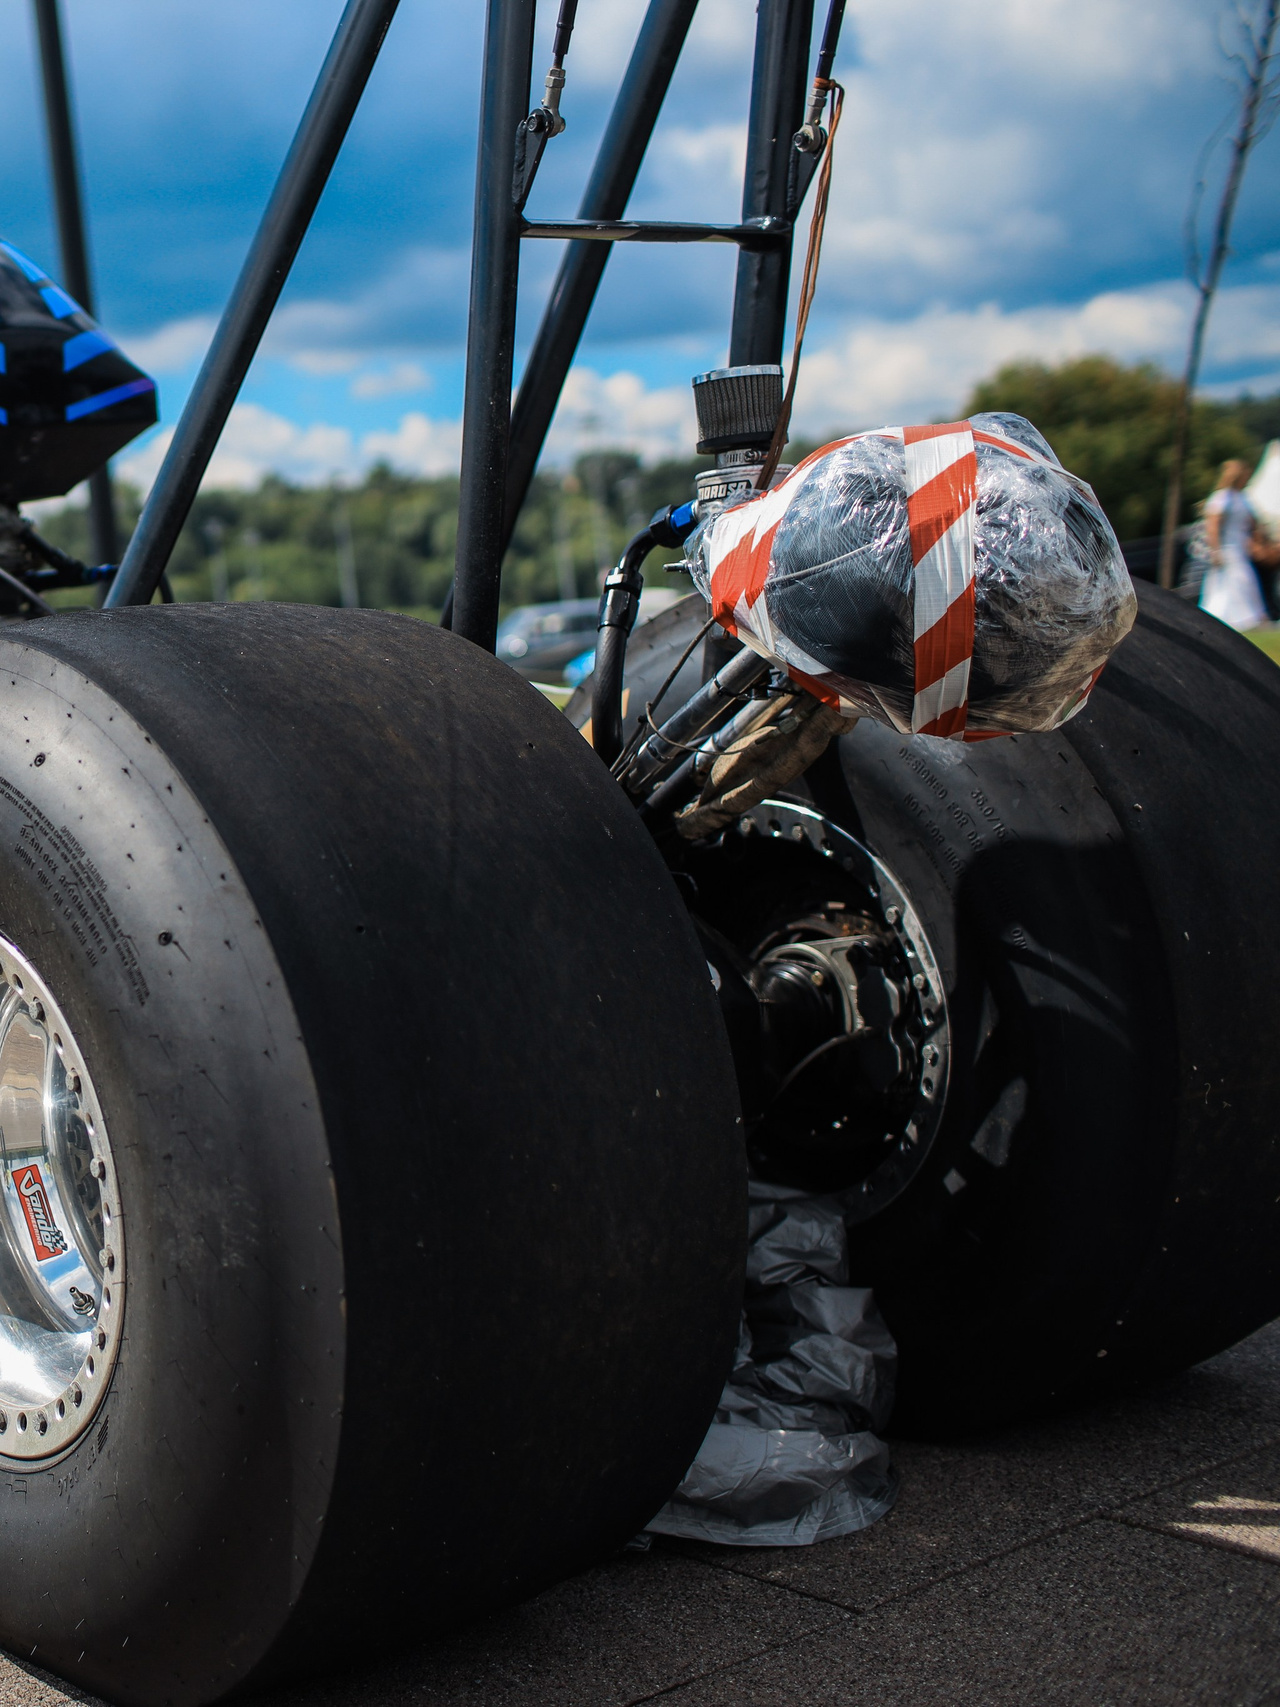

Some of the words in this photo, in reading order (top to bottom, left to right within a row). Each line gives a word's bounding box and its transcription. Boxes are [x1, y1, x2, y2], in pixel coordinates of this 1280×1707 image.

[898, 747, 948, 800] DESIGNED
[947, 802, 969, 828] FOR
[904, 793, 925, 818] NOT
[925, 820, 946, 844] FOR
[18, 827, 59, 875] BEADLOCK
[57, 875, 108, 954] RECOMMENDED
[19, 1170, 54, 1251] Sander
[24, 1197, 42, 1245] ENGINEERING
